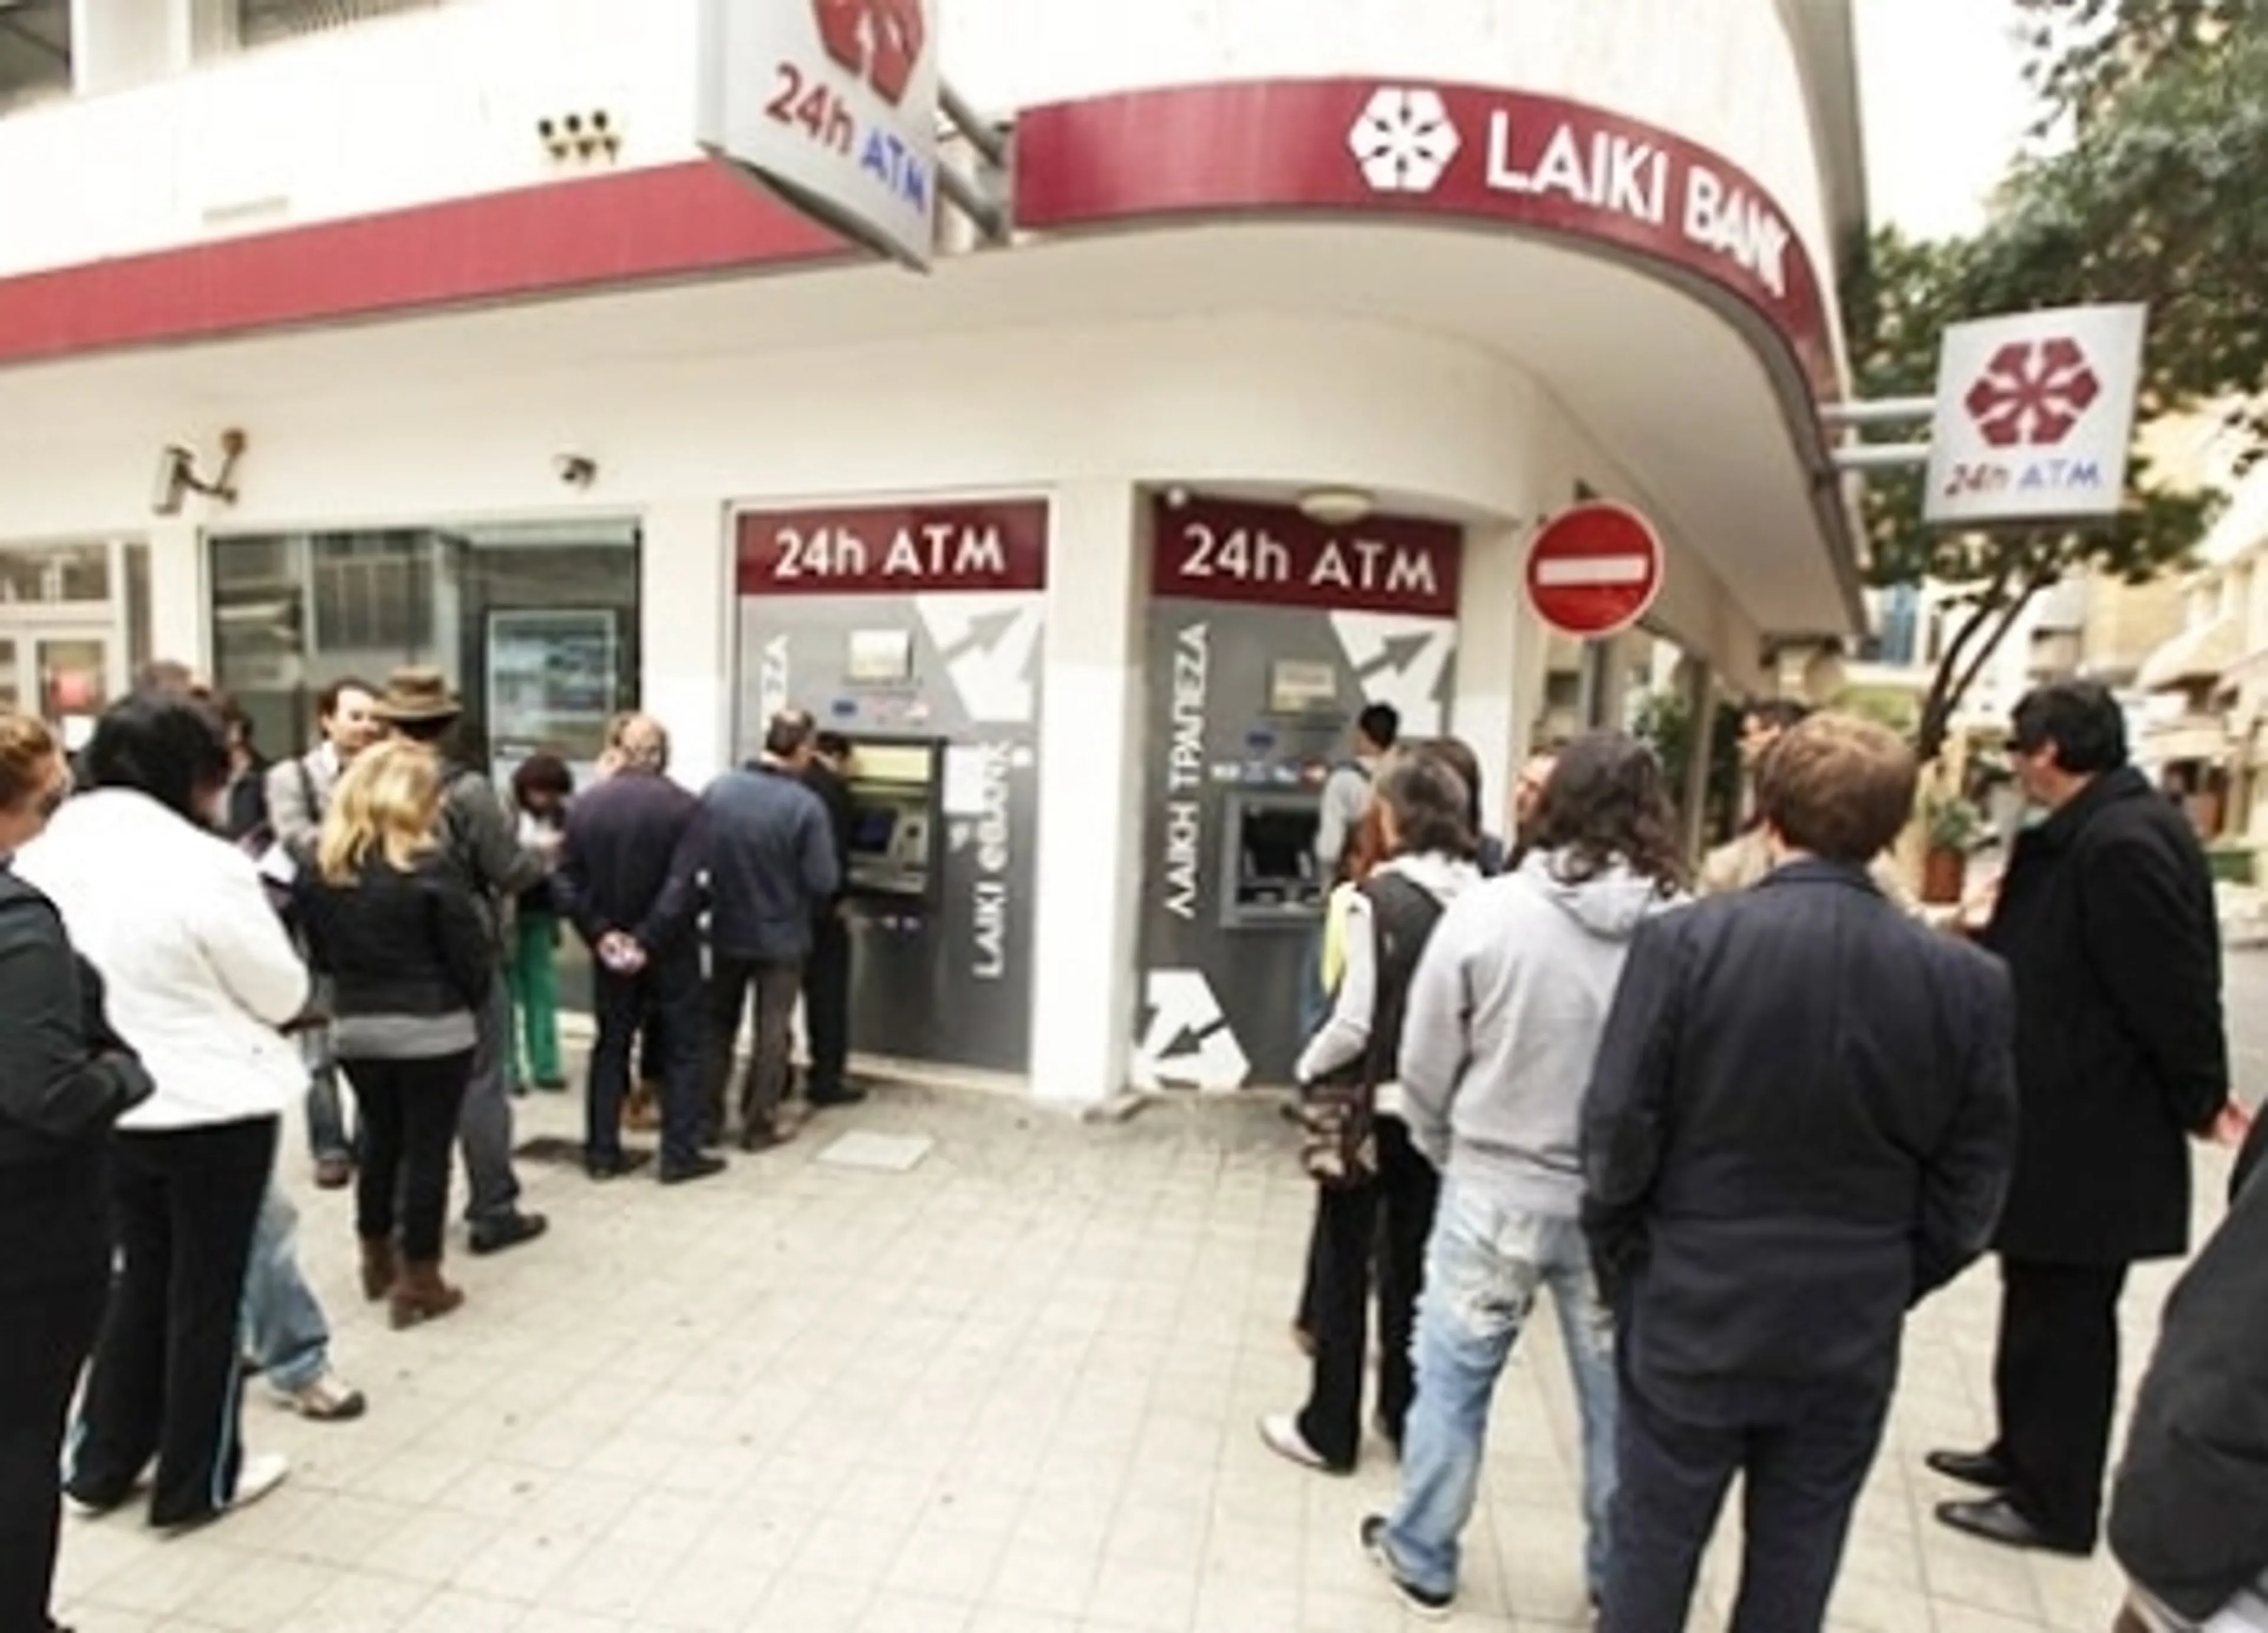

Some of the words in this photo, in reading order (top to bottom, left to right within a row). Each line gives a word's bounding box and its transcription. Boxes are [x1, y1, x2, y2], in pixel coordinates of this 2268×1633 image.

[765, 61, 854, 156] 24h
[861, 127, 927, 217] ATM
[1486, 109, 1670, 226] LAIKI
[1683, 164, 1791, 299] BANK
[1944, 462, 2010, 500] 24h
[2016, 458, 2101, 492] ATM
[773, 526, 867, 578] 24h
[882, 524, 1006, 576] ATM
[1179, 523, 1290, 582] 24h
[1308, 538, 1437, 595] ATM
[971, 881, 1006, 979] LAIKI
